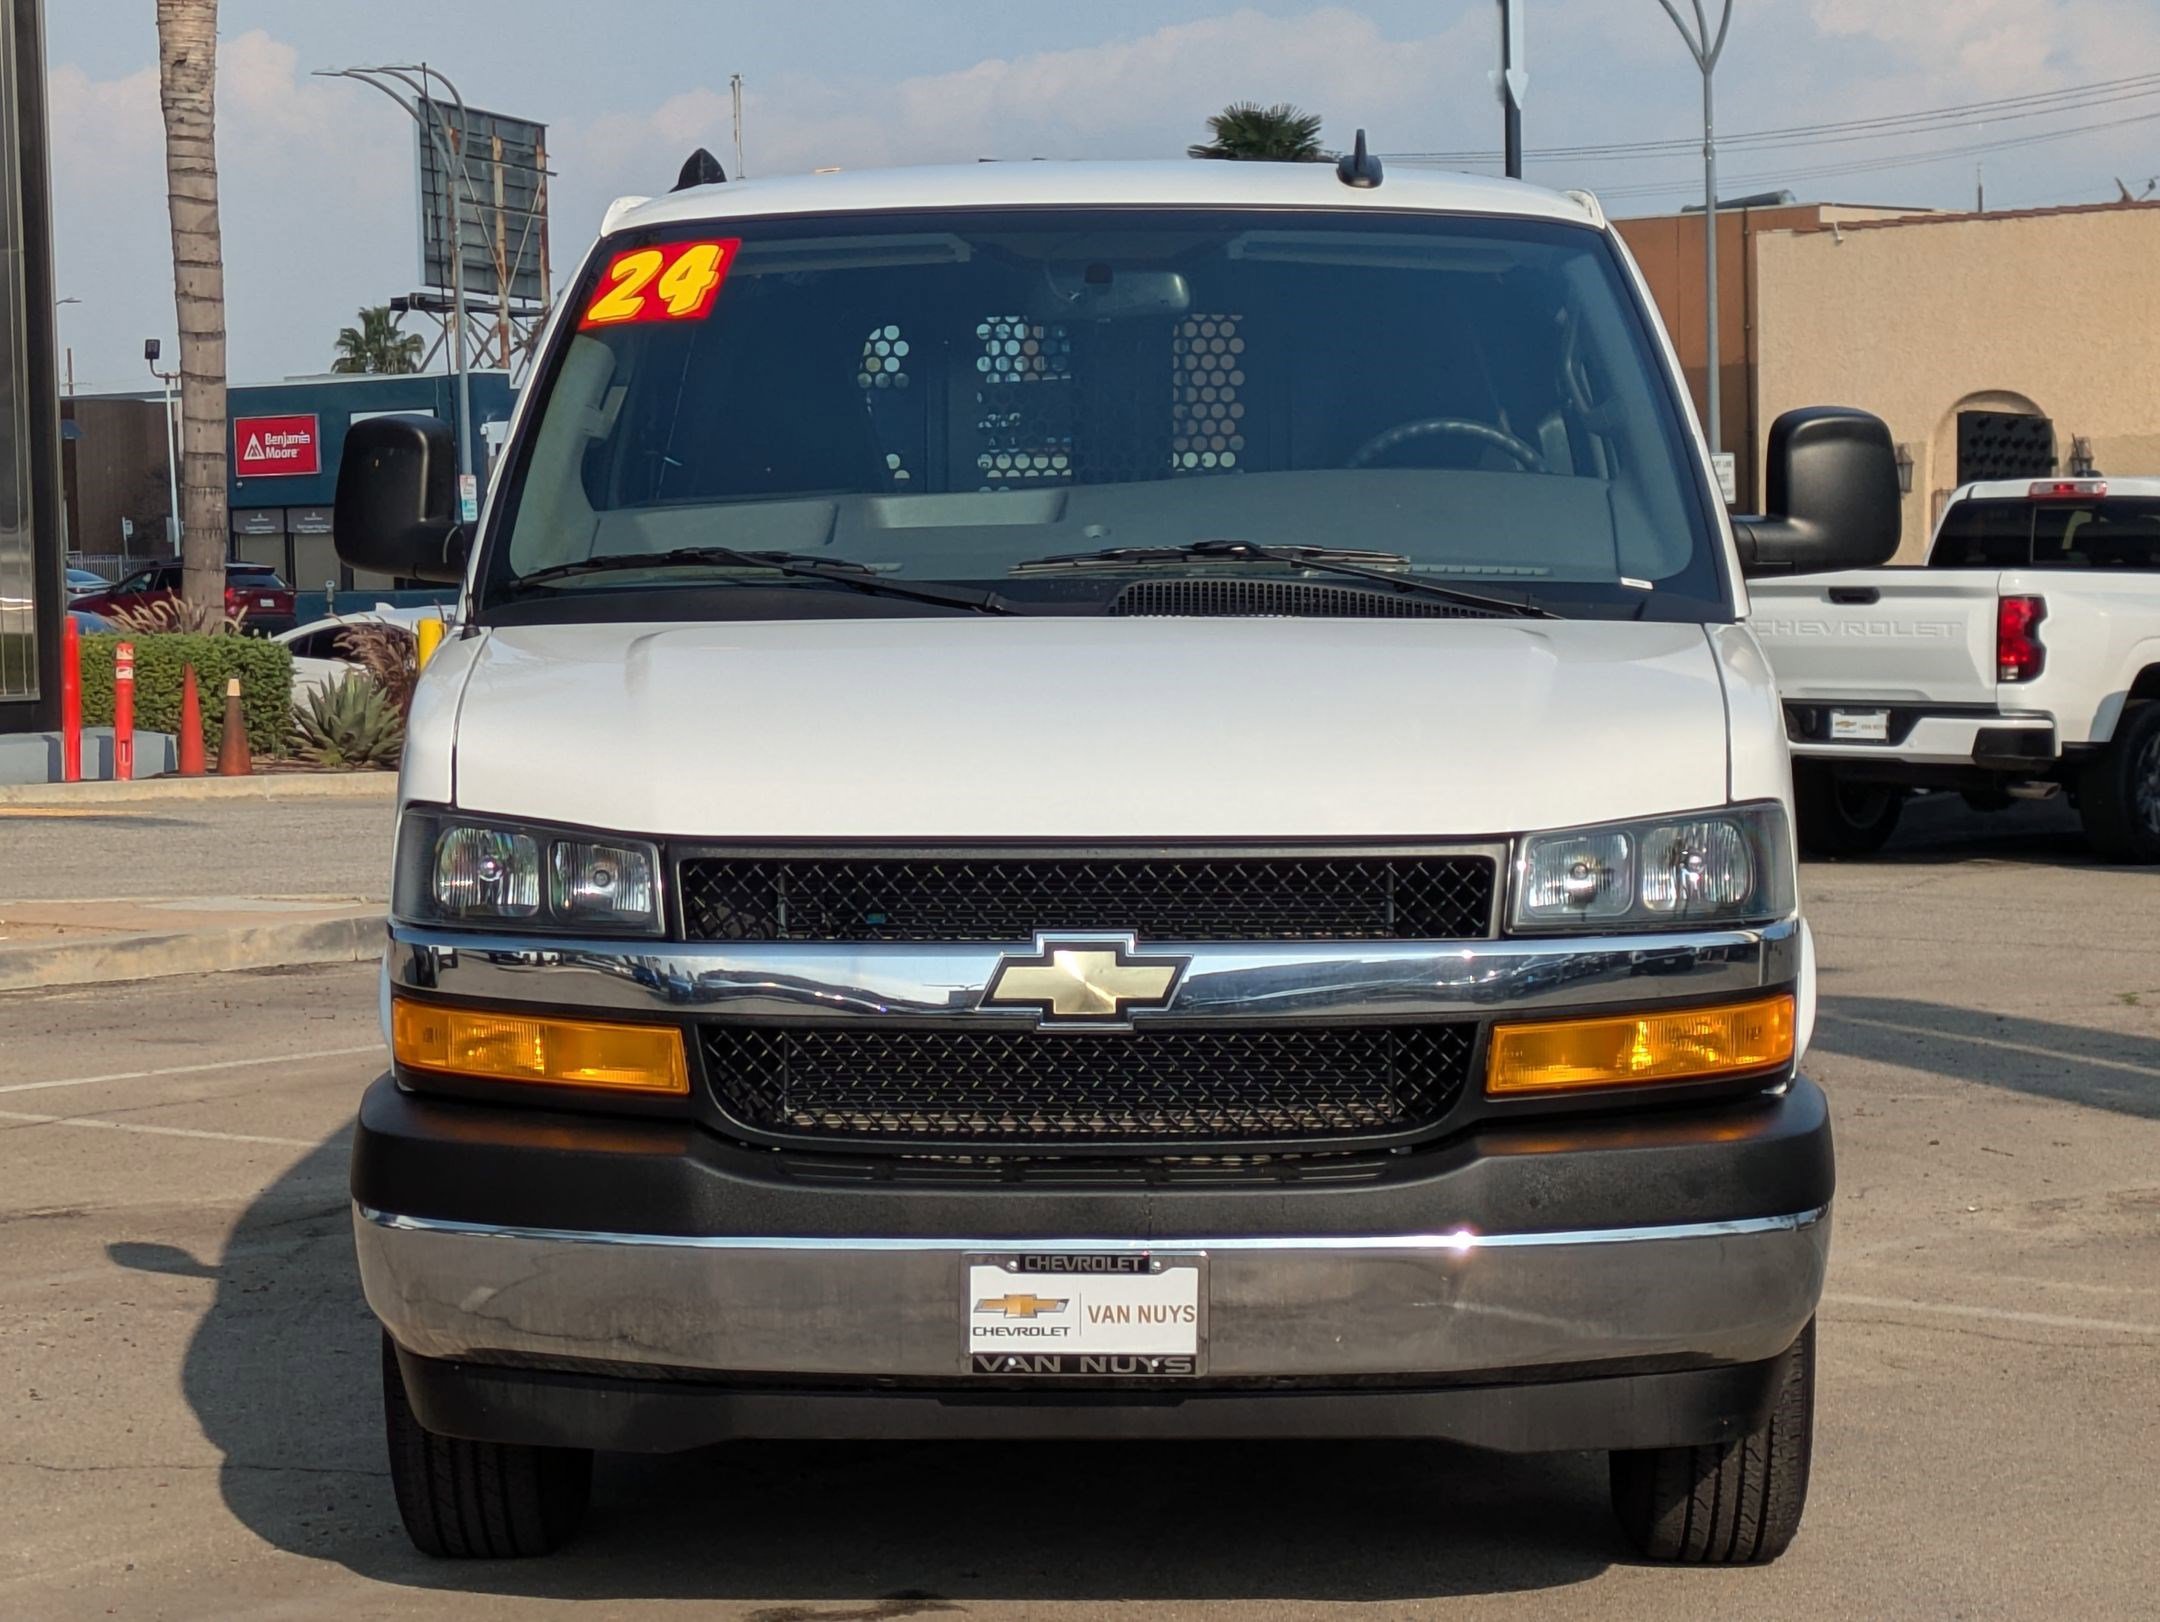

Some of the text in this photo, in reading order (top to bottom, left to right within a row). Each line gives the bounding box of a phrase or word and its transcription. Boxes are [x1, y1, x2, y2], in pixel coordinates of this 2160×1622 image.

[588, 244, 724, 322] 24
[266, 447, 297, 459] Moore
[1754, 619, 1963, 638] CHEVROLET
[1024, 1255, 1143, 1272] CHEVROLET
[1087, 1304, 1196, 1324] VAN NUYS
[972, 1326, 1071, 1337] CHEVROLET
[975, 1355, 1193, 1374] VAN NUYS
